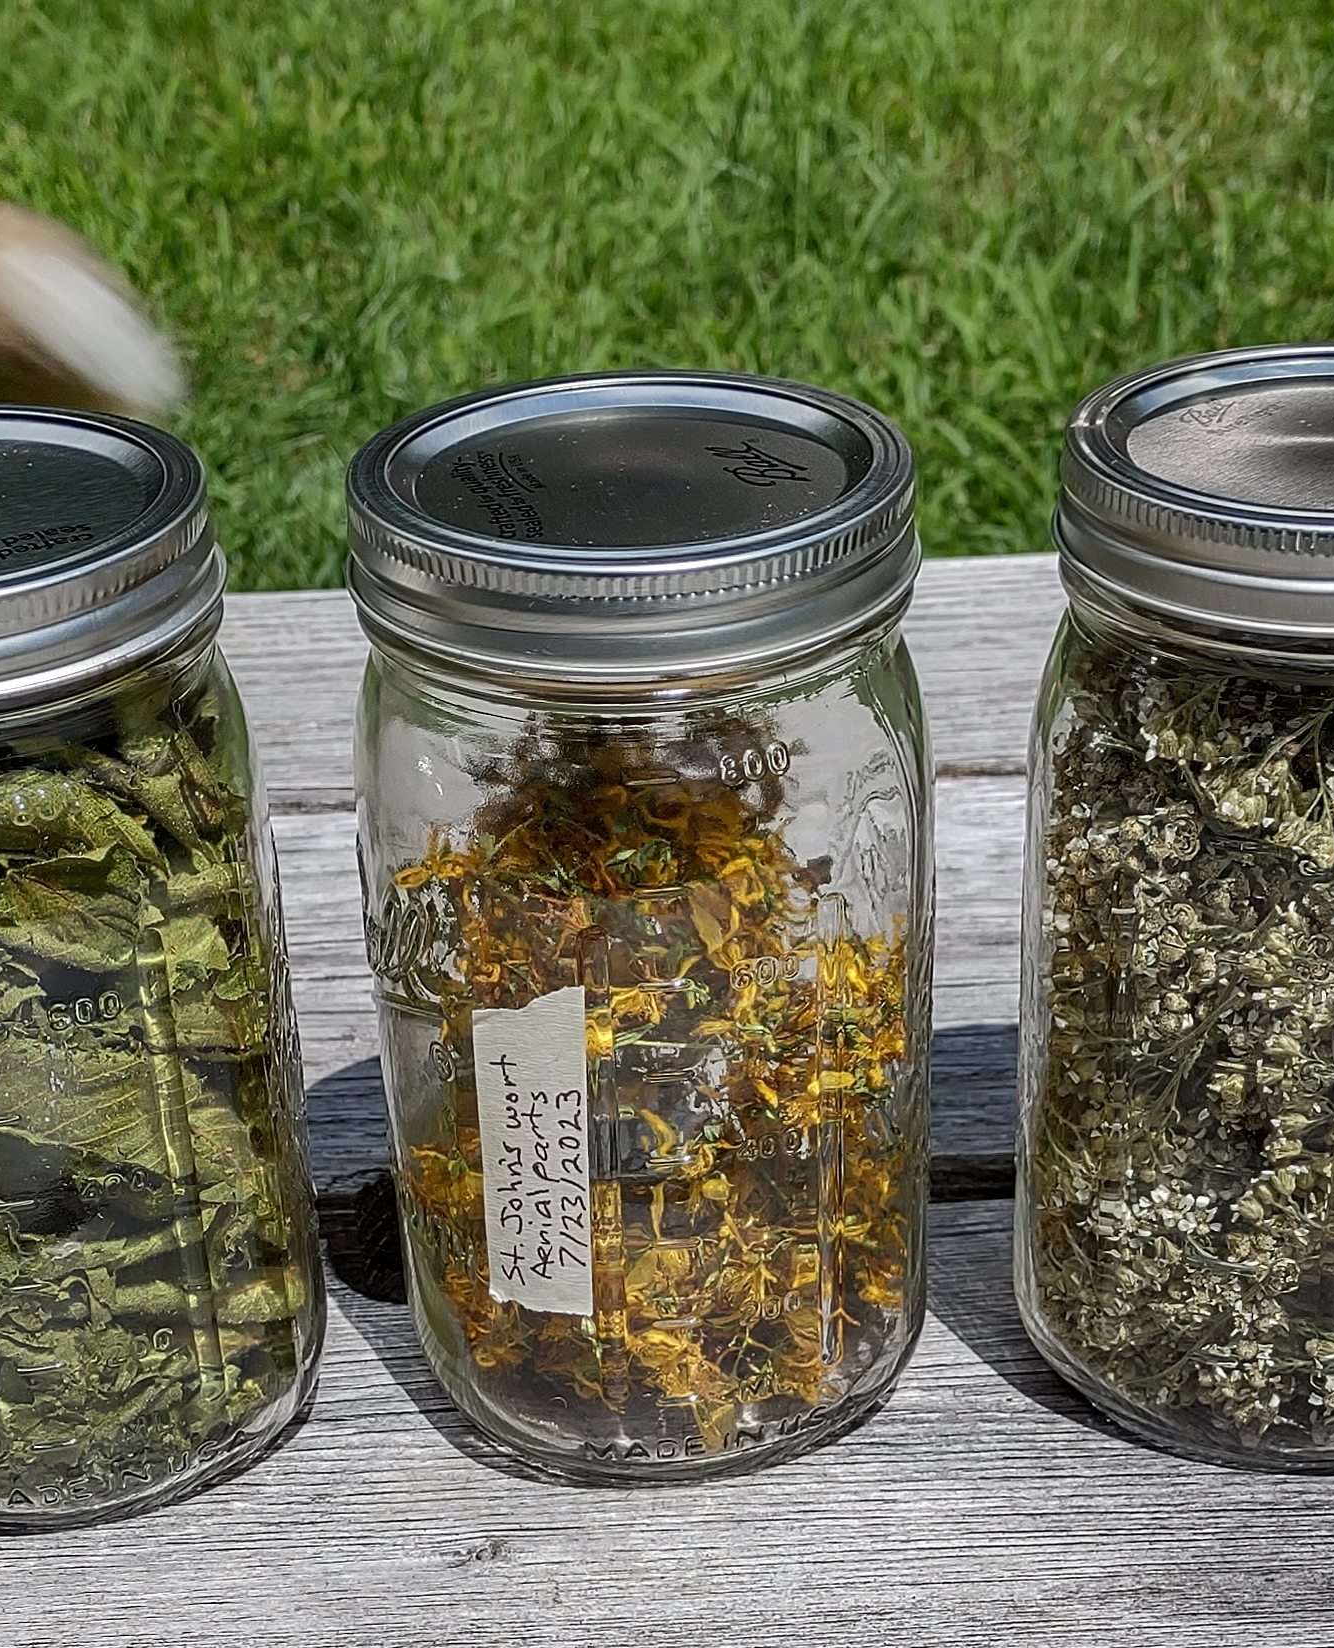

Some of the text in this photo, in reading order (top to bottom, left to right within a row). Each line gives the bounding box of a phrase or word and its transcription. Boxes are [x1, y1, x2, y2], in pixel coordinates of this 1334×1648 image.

[704, 441, 811, 487] Ball
[0, 523, 93, 547] sealed
[719, 741, 792, 787] 800
[729, 952, 801, 991] 600
[48, 989, 123, 1031] 600
[489, 1053, 520, 1131] wort
[521, 1091, 560, 1280] Aerial parts
[555, 1089, 588, 1267] 7/23/2023
[500, 1242, 527, 1286] St.
[584, 1435, 707, 1461] MADE
[723, 1424, 765, 1449] IN
[107, 1463, 152, 1492] IN
